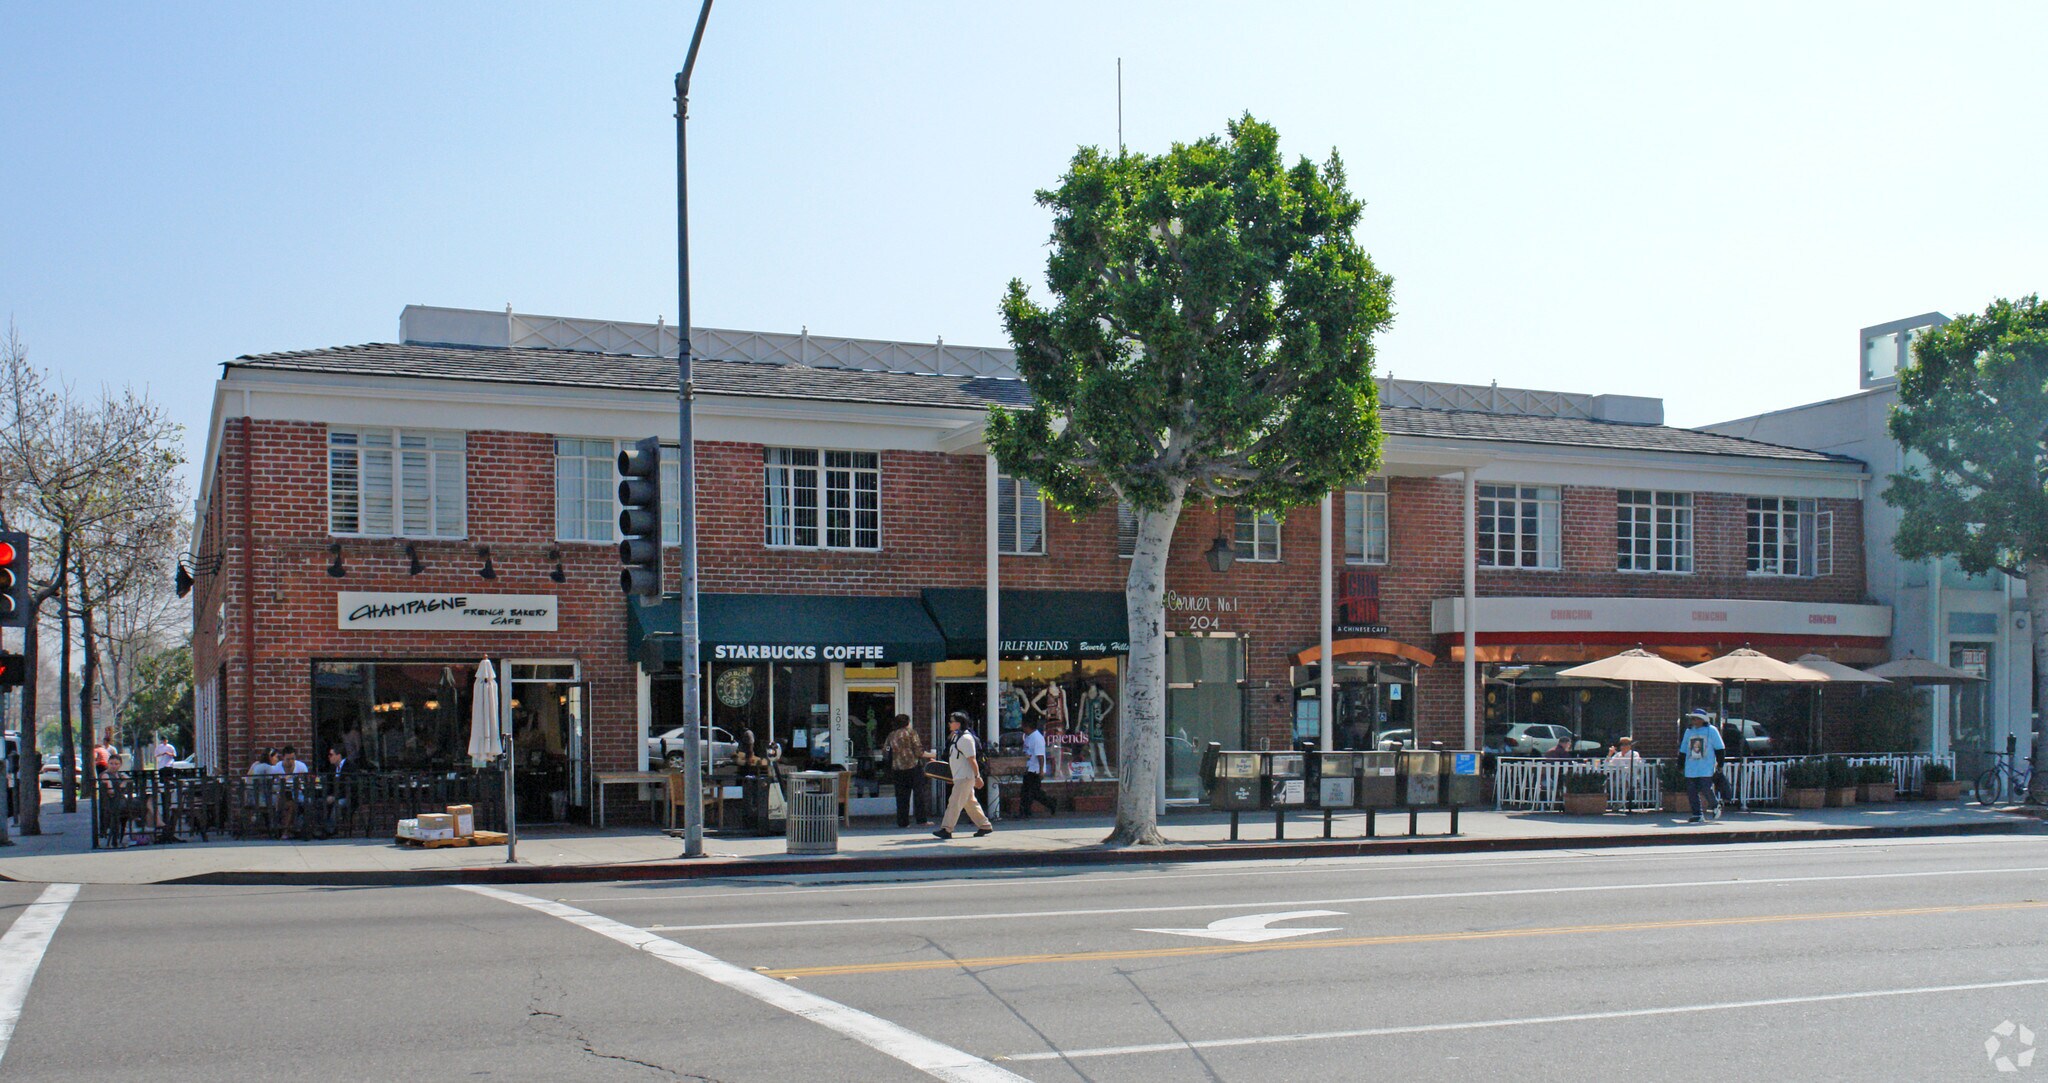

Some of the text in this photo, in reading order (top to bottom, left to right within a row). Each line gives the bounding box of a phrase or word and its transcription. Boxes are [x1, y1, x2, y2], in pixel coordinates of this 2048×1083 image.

[1167, 589, 1211, 611] Corner
[348, 596, 468, 621] CHAMPAGNE
[463, 608, 548, 617] FRENCH BAKERY
[490, 616, 522, 625] CAFE
[1189, 616, 1219, 630] 204
[715, 645, 884, 659] STARBUCKS COFFEE
[999, 640, 1069, 651] IRLFRIENDS
[1080, 641, 1107, 652] Beverly
